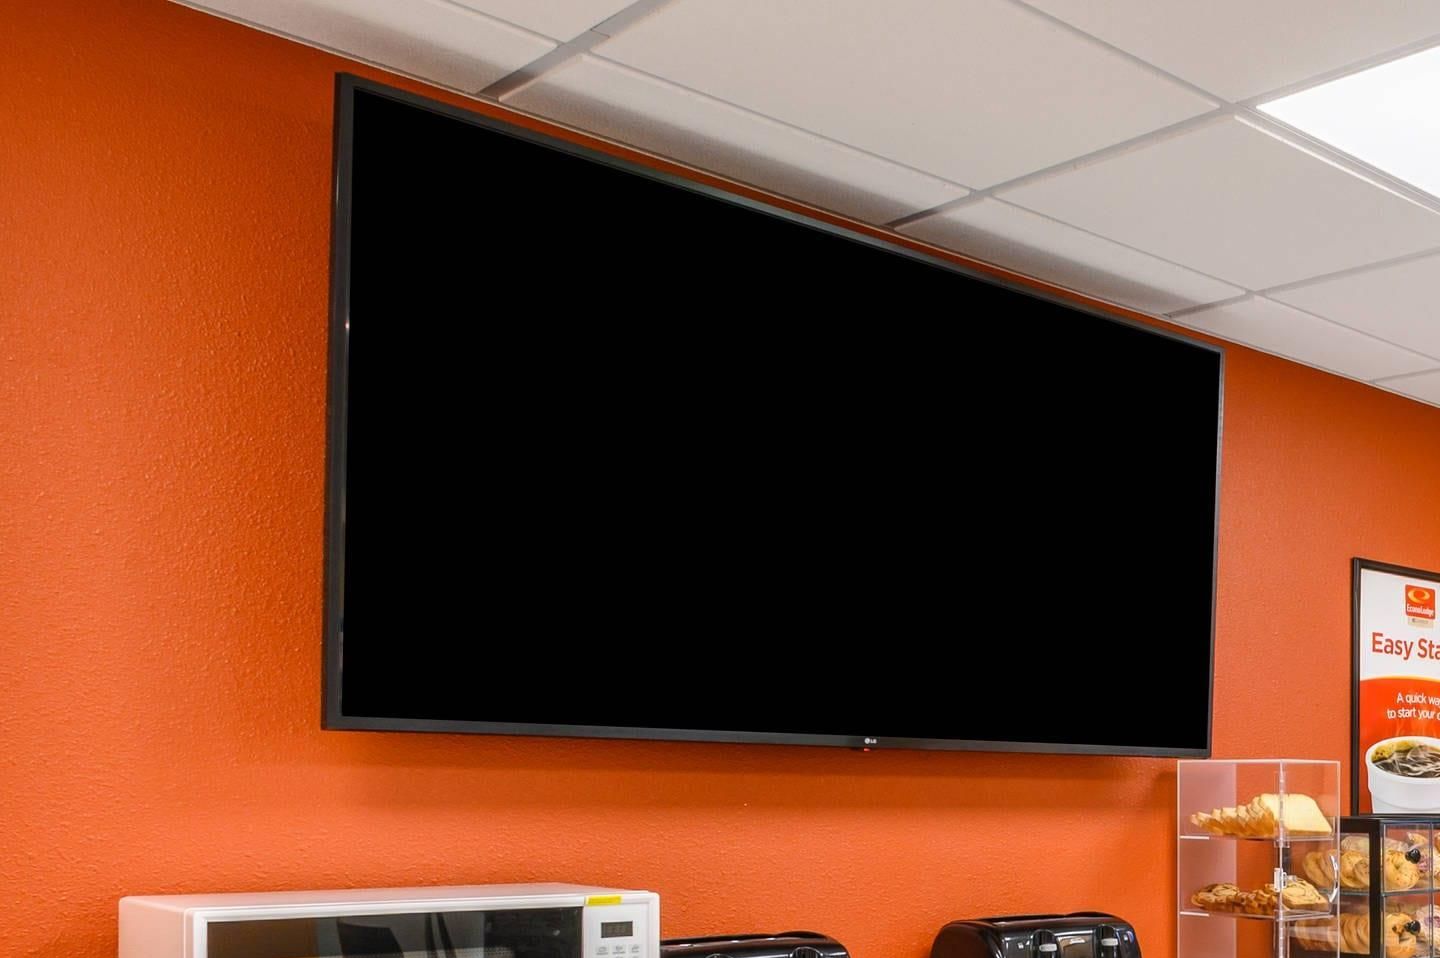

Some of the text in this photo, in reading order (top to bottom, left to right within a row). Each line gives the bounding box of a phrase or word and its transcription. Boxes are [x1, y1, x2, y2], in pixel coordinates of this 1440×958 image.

[1372, 632, 1414, 661] Easy
[1396, 692, 1405, 704] A
[1405, 692, 1427, 706] quick
[1387, 708, 1397, 719] to
[1397, 707, 1416, 719] start
[1417, 709, 1436, 720] your
